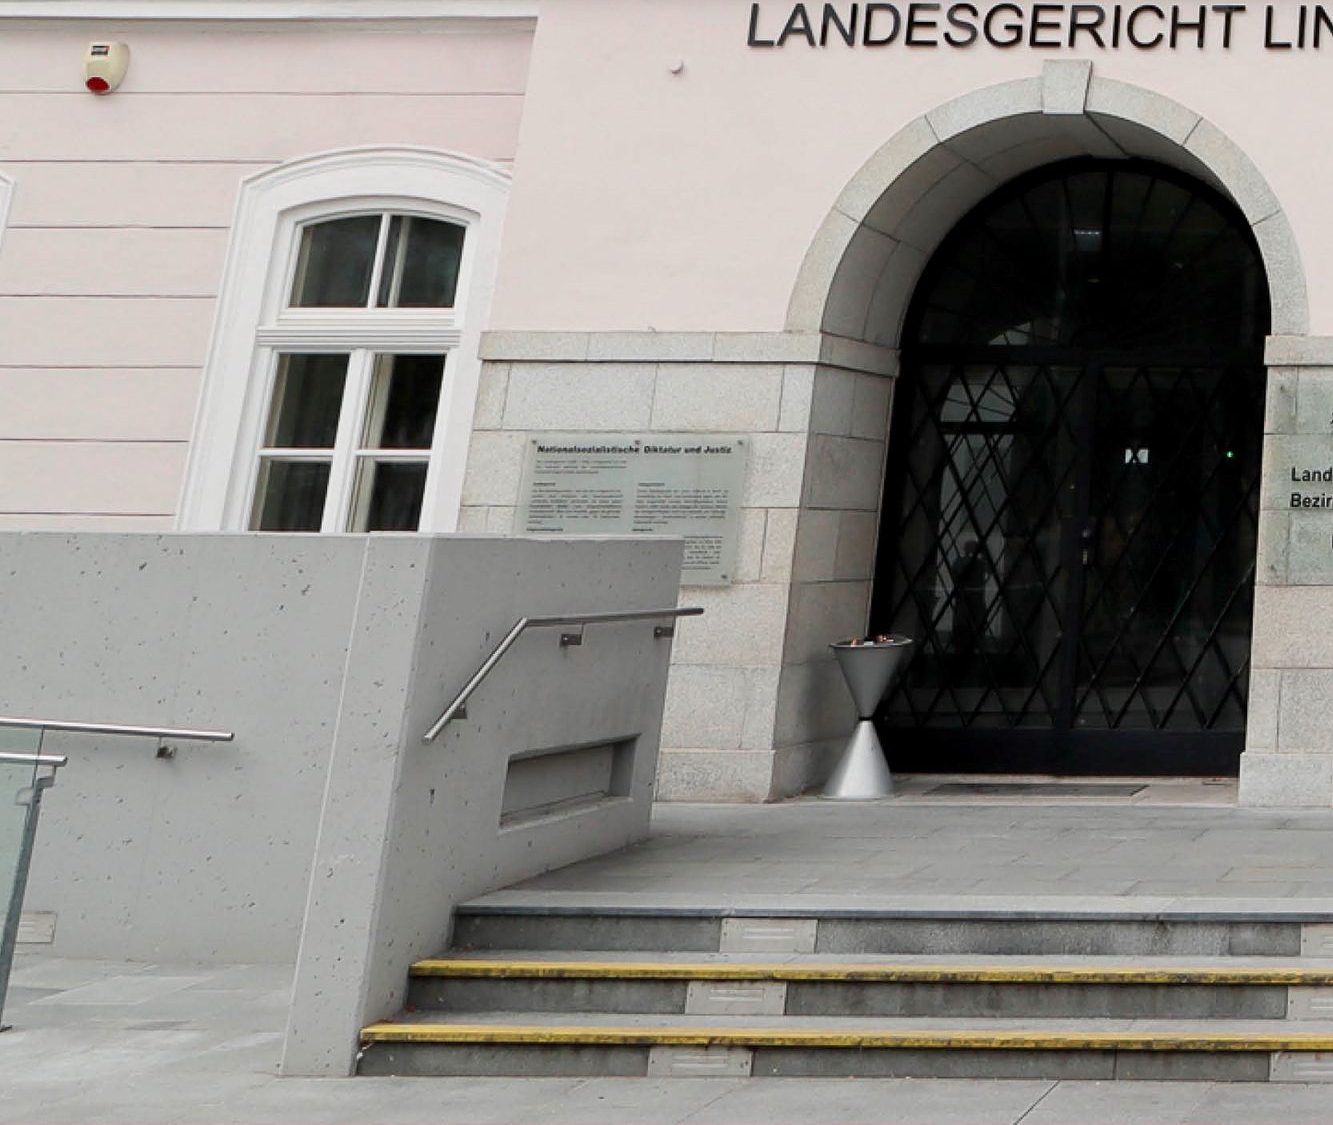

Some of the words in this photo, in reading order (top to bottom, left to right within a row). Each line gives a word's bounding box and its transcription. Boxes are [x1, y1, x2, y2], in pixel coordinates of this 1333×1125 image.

[746, 3, 1246, 49] LANDESGERICHT
[536, 445, 640, 454] Nationalsozialistische
[643, 445, 682, 454] Diktatur
[684, 446, 702, 454] und
[703, 446, 732, 454] Justiz
